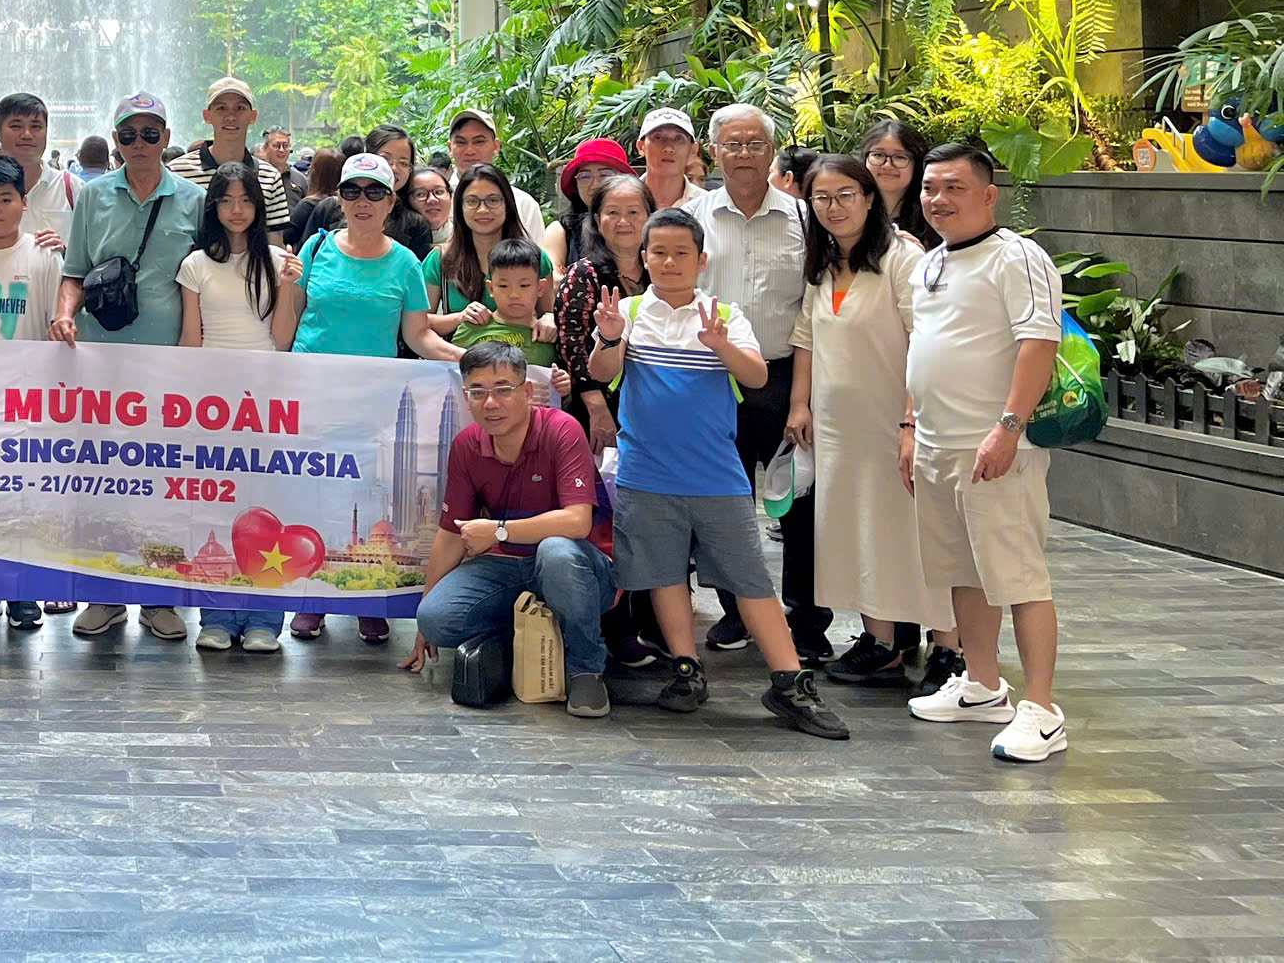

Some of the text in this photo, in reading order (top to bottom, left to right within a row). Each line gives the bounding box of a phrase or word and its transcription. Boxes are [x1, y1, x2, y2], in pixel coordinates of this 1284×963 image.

[0, 298, 27, 315] NEVER
[3, 381, 148, 426] MỪNG
[161, 390, 301, 435] ĐOÀN
[1, 438, 361, 479] SINGAPORE-MALAYSIA
[40, 475, 154, 497] 21/07/2025
[163, 476, 236, 503] XE02
